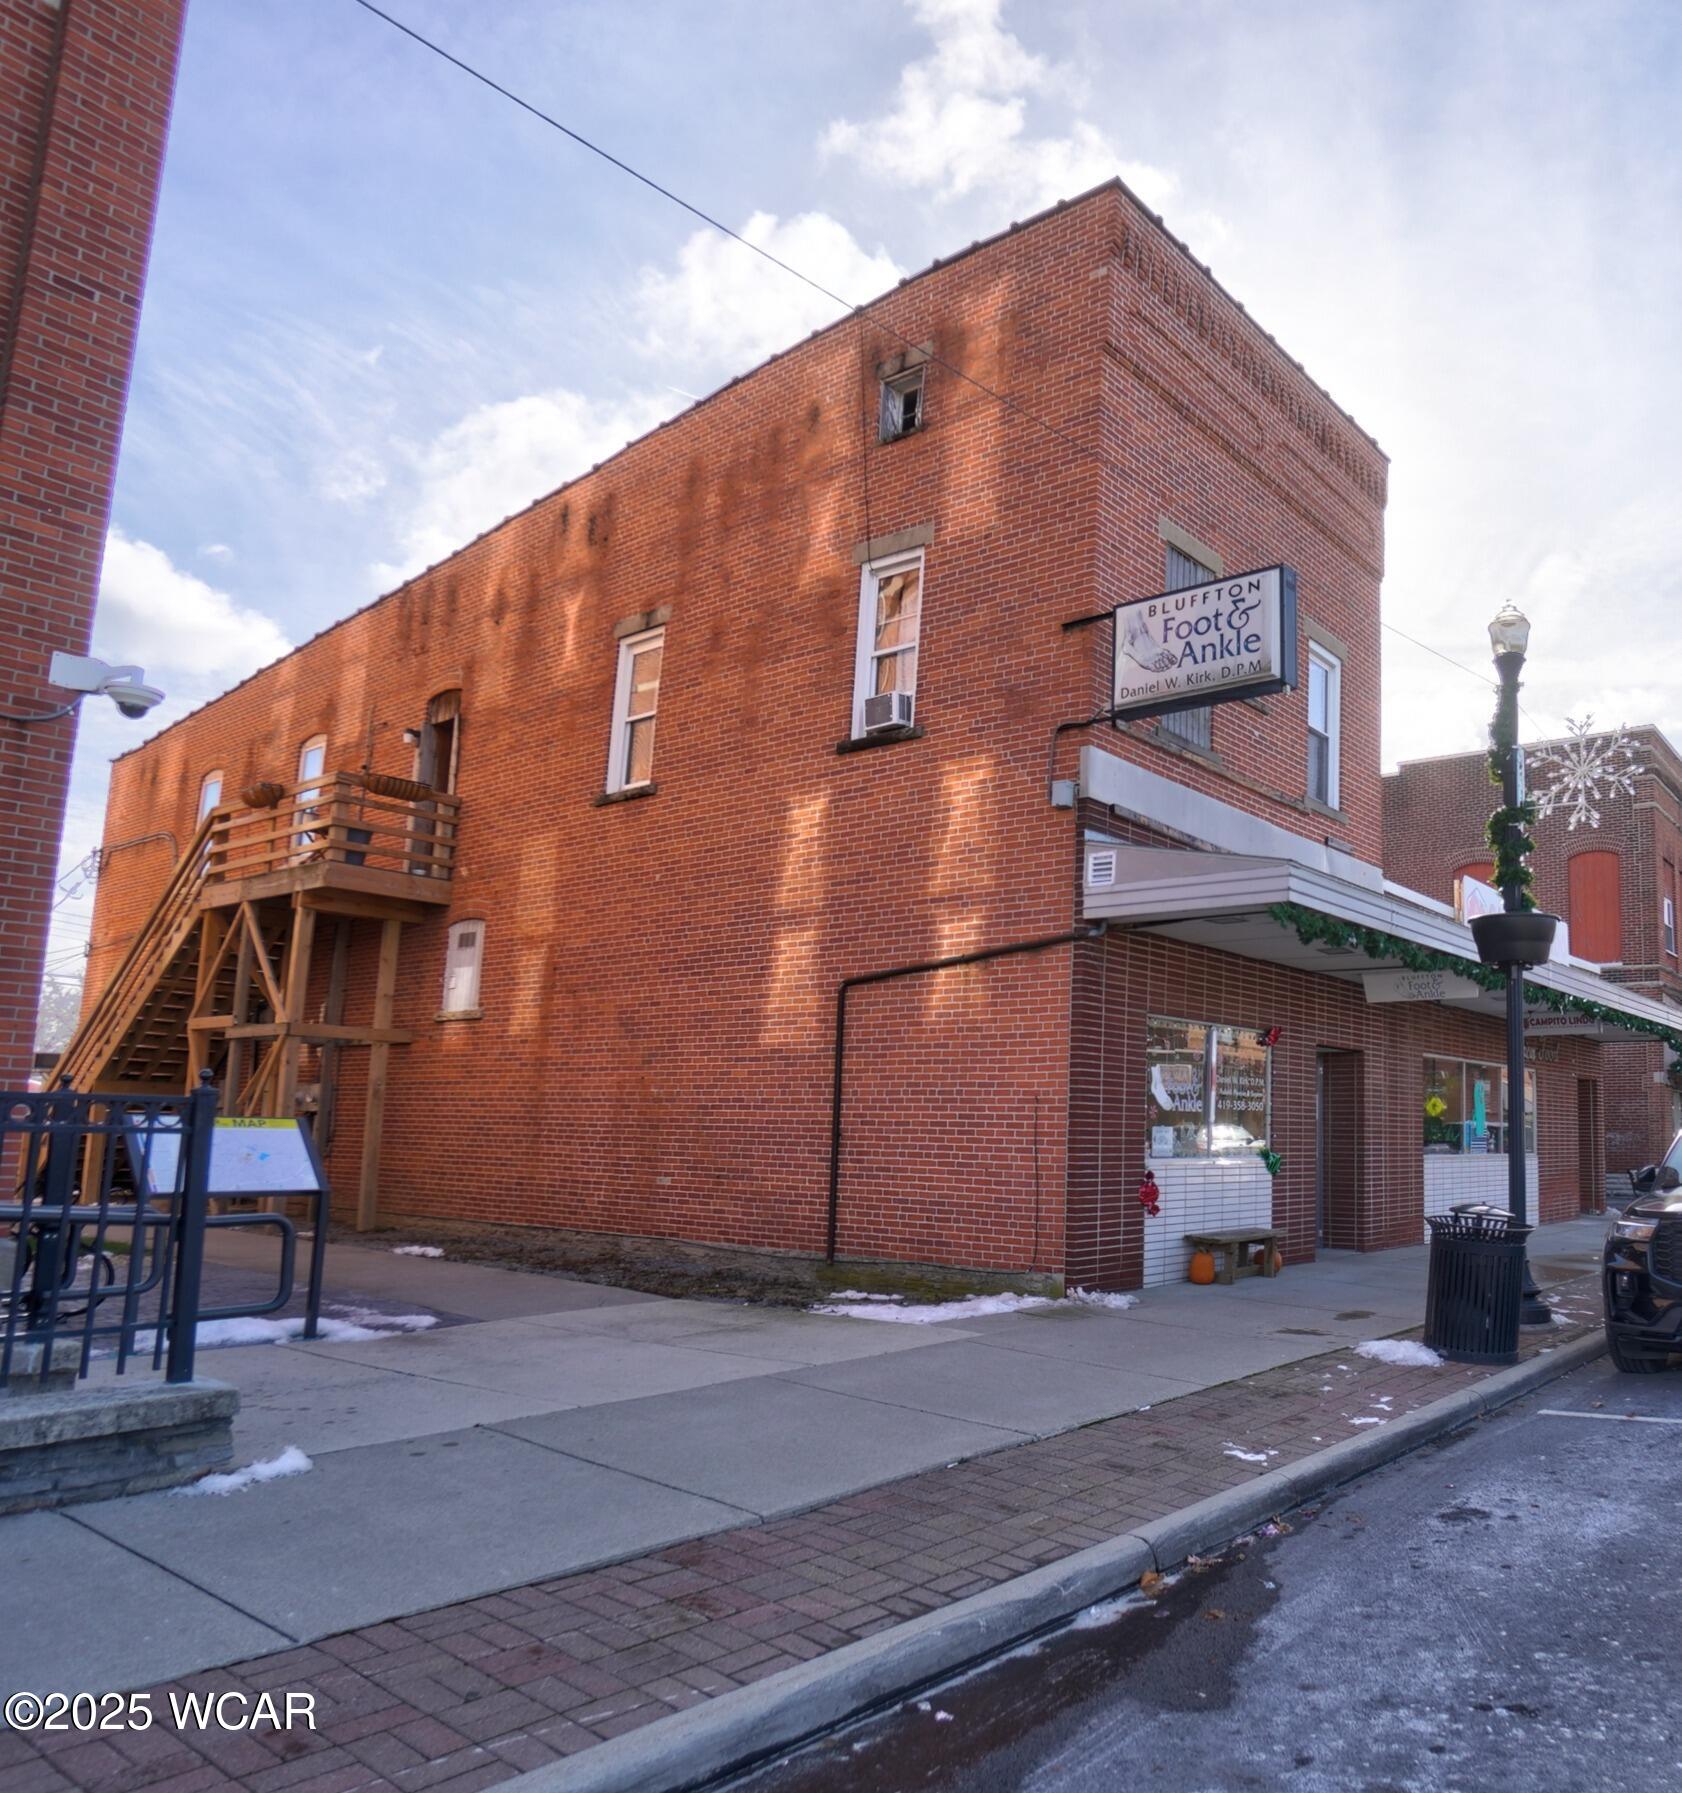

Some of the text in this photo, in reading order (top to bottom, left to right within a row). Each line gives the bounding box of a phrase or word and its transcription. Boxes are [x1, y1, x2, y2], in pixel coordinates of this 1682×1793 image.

[1148, 578, 1260, 618] BLUFFTON
[1162, 597, 1261, 644] Foot &
[1176, 629, 1261, 669] Ankle
[1120, 681, 1160, 699] Daniel
[1165, 677, 1181, 690] W.
[1408, 981, 1431, 991] Foot
[1416, 989, 1446, 999] Ankle
[1530, 1016, 1567, 1026] CAMPITO
[1172, 1094, 1203, 1112] Ankle
[1217, 1100, 1264, 1112] 419-358-3050
[231, 1119, 267, 1128] MAP
